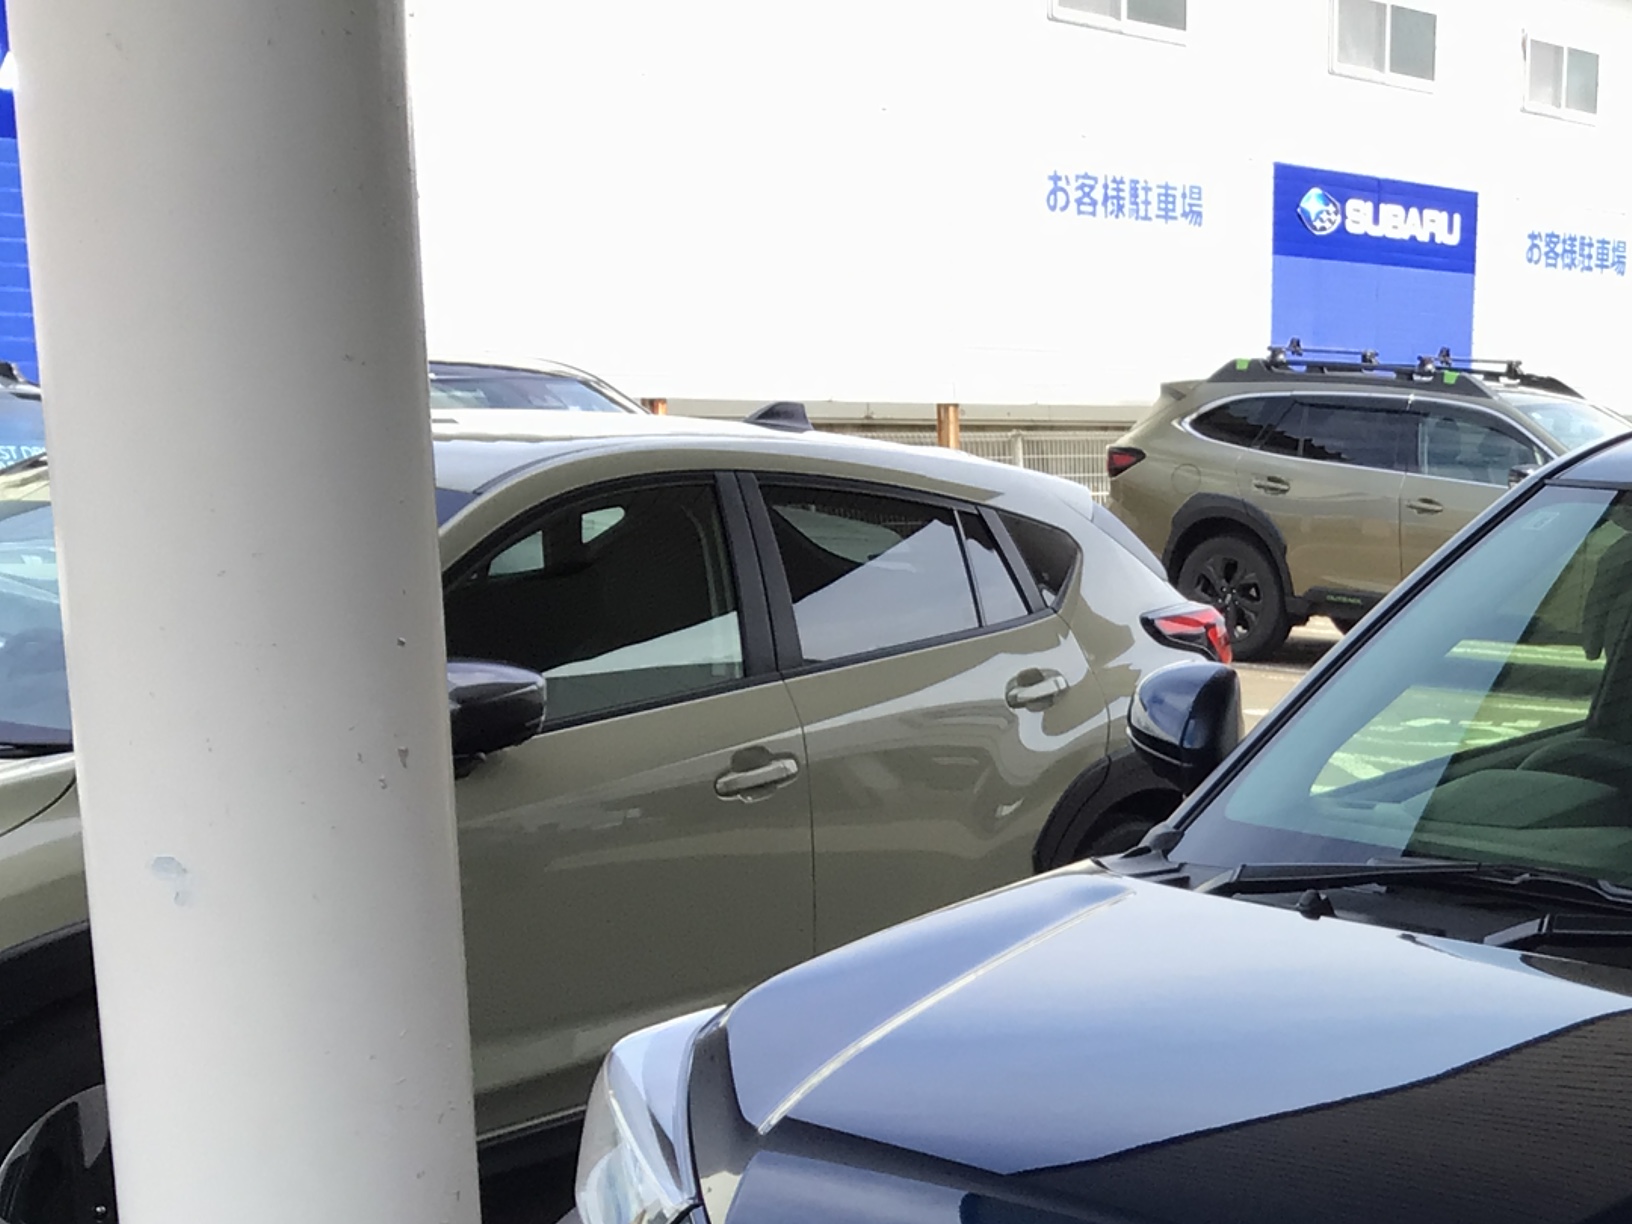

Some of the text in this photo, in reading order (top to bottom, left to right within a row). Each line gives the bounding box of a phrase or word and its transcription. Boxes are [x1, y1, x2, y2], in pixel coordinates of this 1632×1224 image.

[1046, 170, 1203, 227] お客様駐車場
[1345, 198, 1461, 246] SUBARU
[1526, 230, 1626, 276] お客様駐車場
